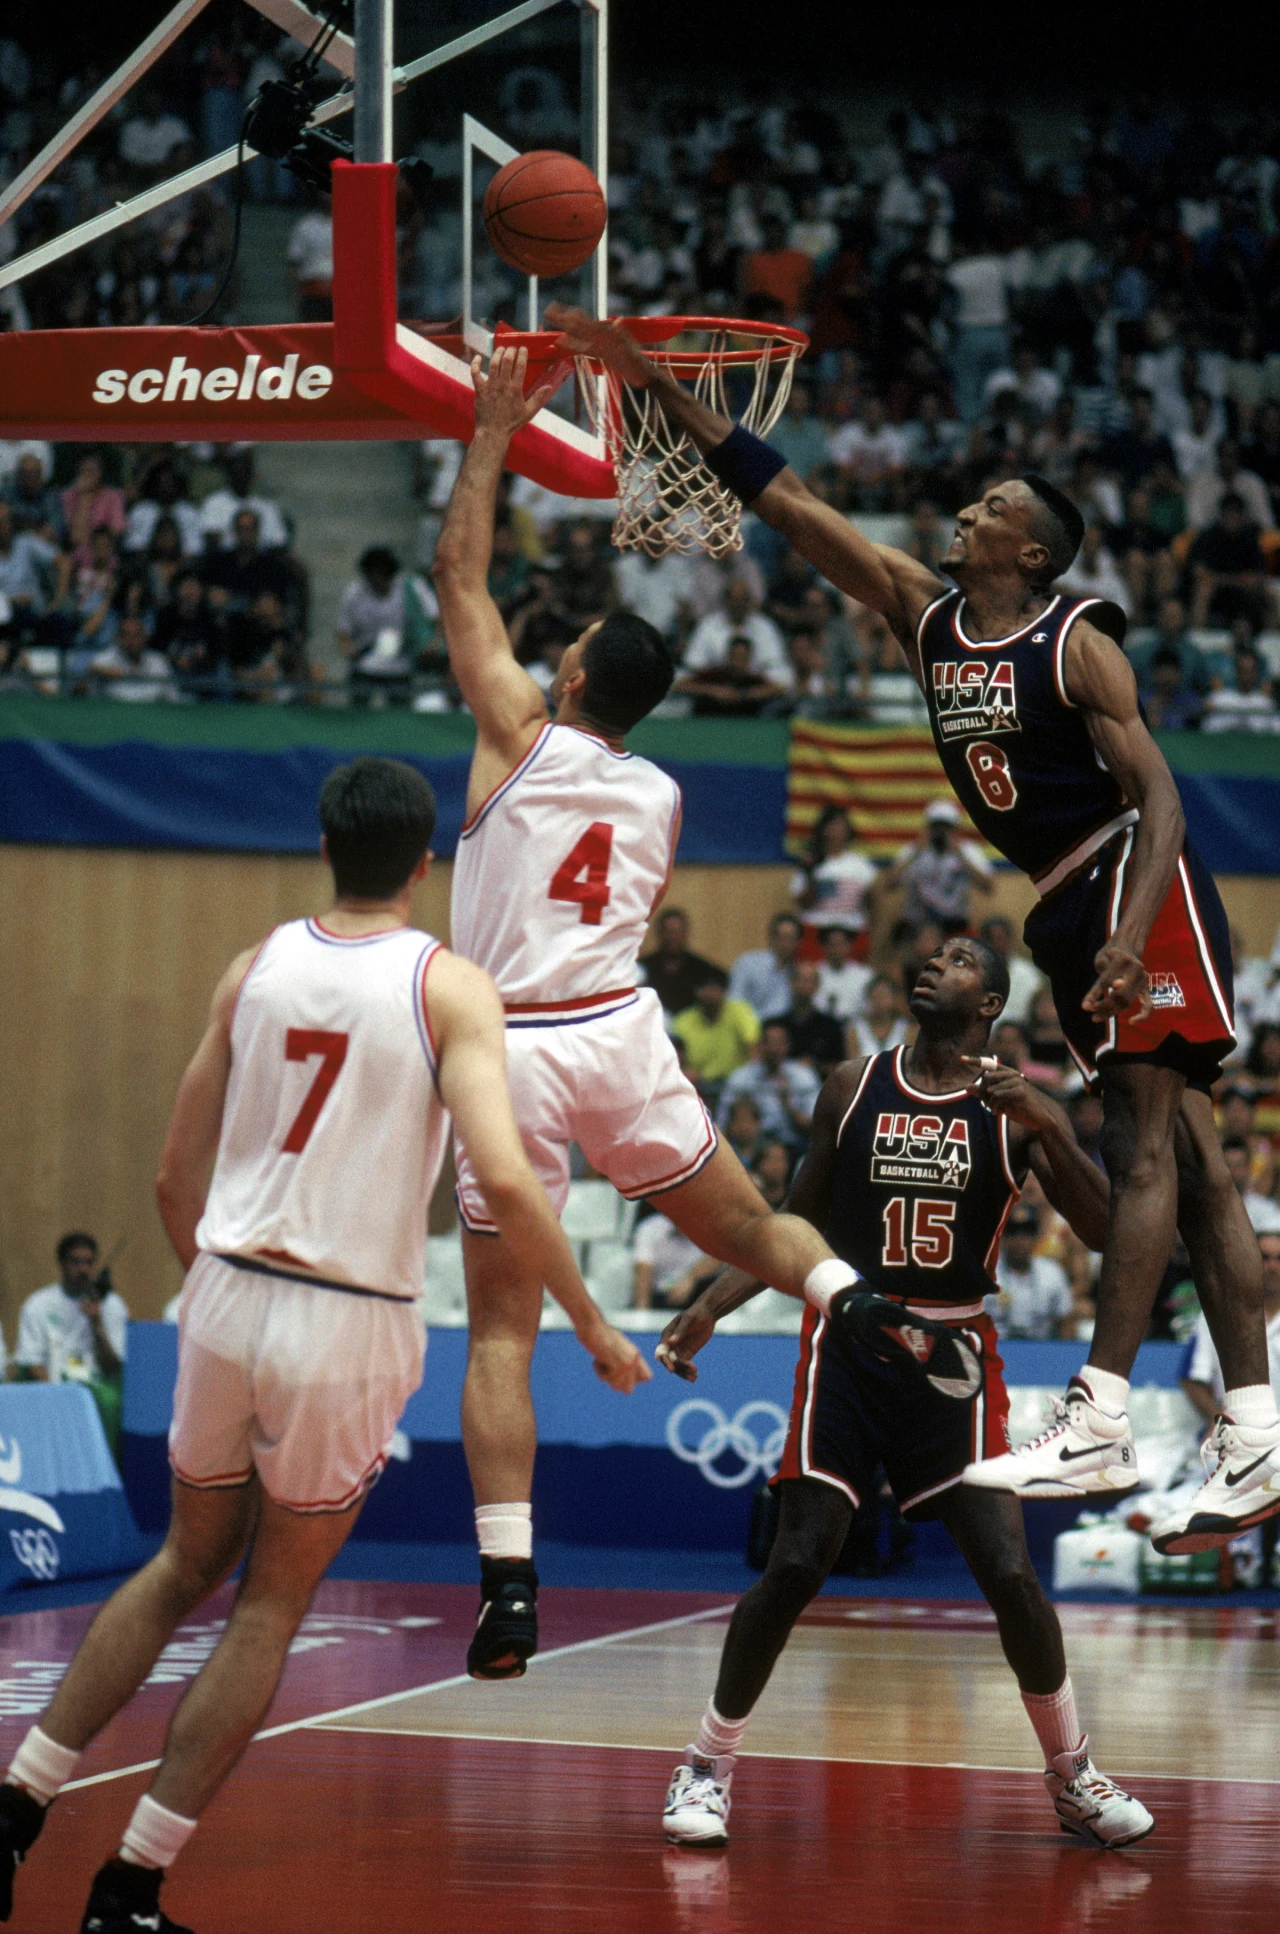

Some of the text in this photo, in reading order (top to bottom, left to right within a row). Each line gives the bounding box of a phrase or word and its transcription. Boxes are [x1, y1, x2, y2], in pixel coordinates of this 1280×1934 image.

[92, 354, 333, 403] schelde
[932, 661, 1016, 715] USA
[942, 716, 988, 733] BASKETBALL
[966, 741, 1018, 812] 8
[547, 821, 613, 926] 4
[279, 1027, 349, 1155] 7
[873, 1113, 971, 1166] USA
[879, 1164, 939, 1179] BASKETBALL
[882, 1197, 956, 1268] 15
[1121, 1447, 1130, 1462] 8
